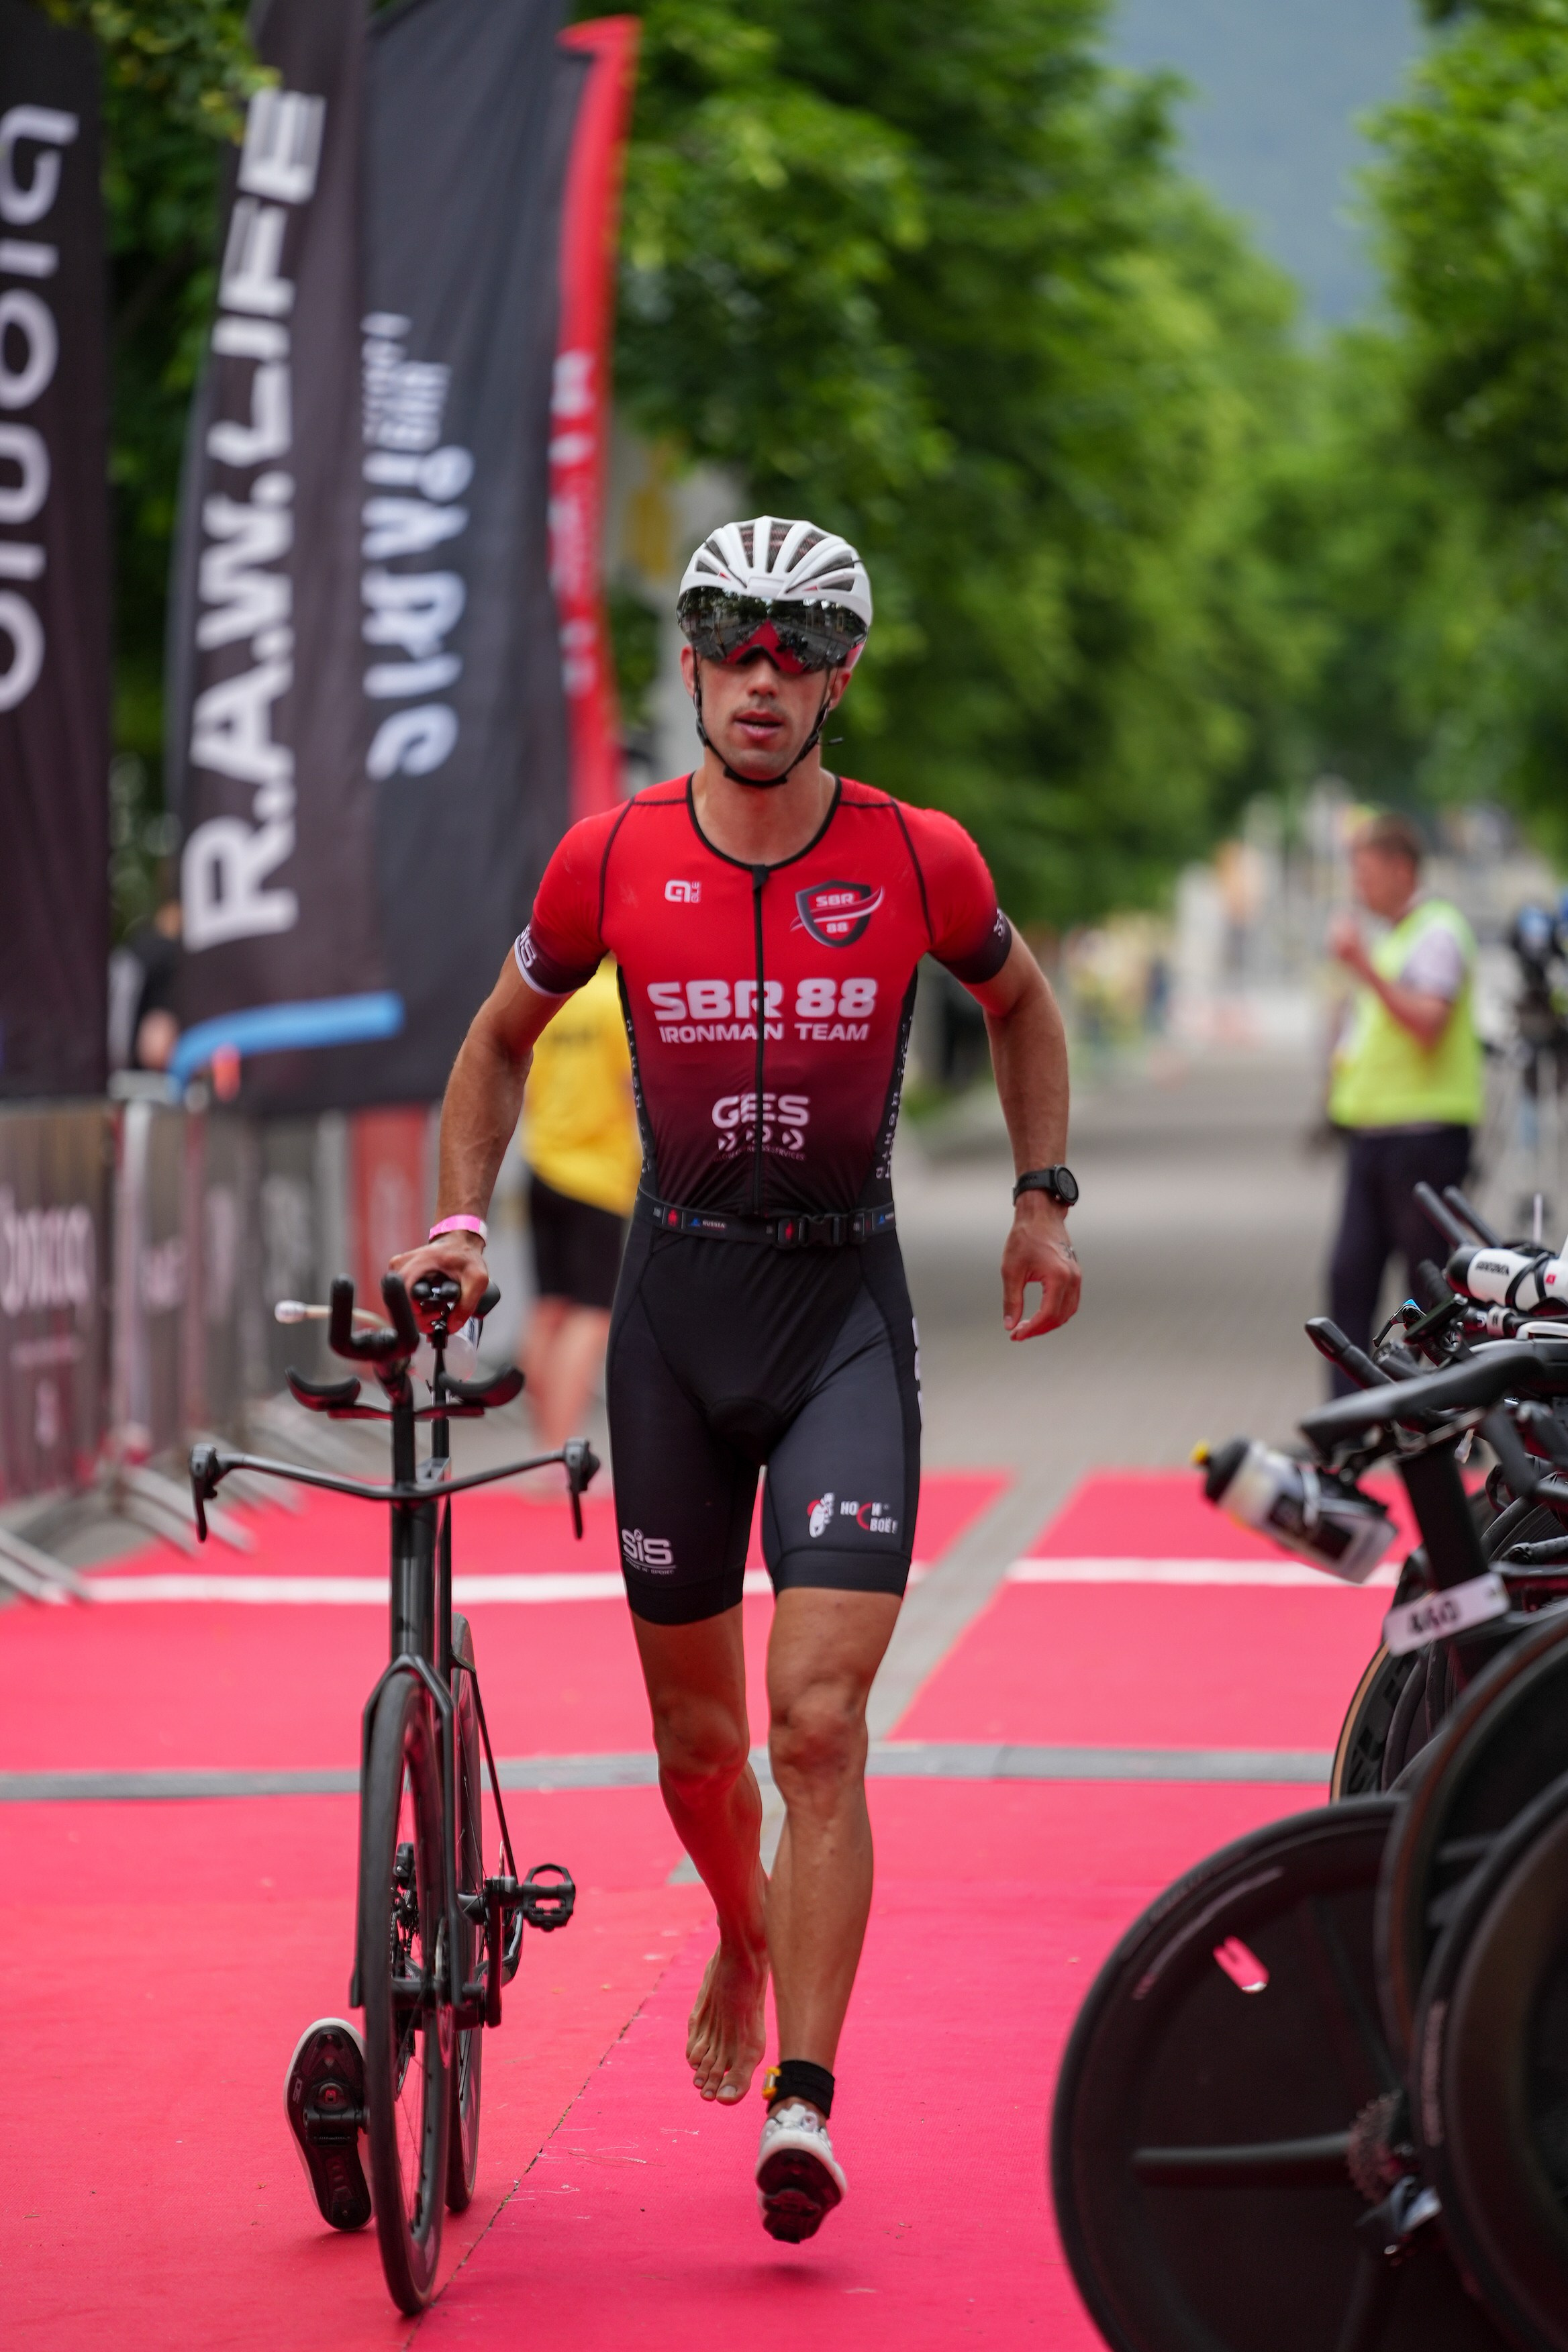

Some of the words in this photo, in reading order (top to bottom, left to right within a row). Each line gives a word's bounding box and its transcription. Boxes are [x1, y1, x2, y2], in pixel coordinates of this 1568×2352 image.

[815, 893, 854, 908] SBR
[826, 921, 849, 934] 88
[646, 979, 784, 1021] SBR
[795, 977, 877, 1018] 88
[658, 1022, 785, 1044] IRONMAN
[794, 1023, 869, 1041] TEAM
[712, 1093, 810, 1129] GES
[702, 1220, 726, 1228] RUSSIA
